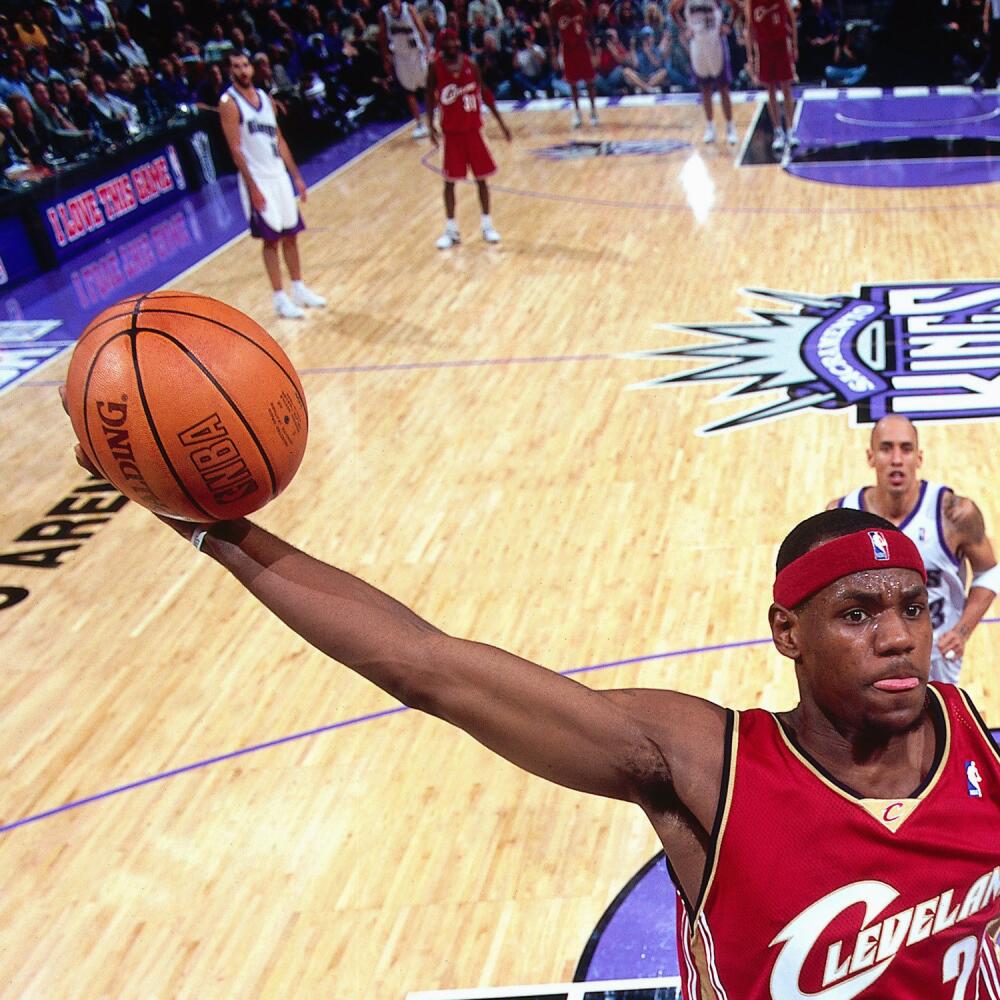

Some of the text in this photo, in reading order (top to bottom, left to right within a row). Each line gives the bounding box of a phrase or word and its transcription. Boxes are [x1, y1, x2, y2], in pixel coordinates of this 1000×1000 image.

[56, 189, 106, 242] LOVE
[95, 173, 138, 221] THIS
[178, 412, 250, 493] NBA
[929, 597, 945, 630] 3
[883, 802, 903, 821] C
